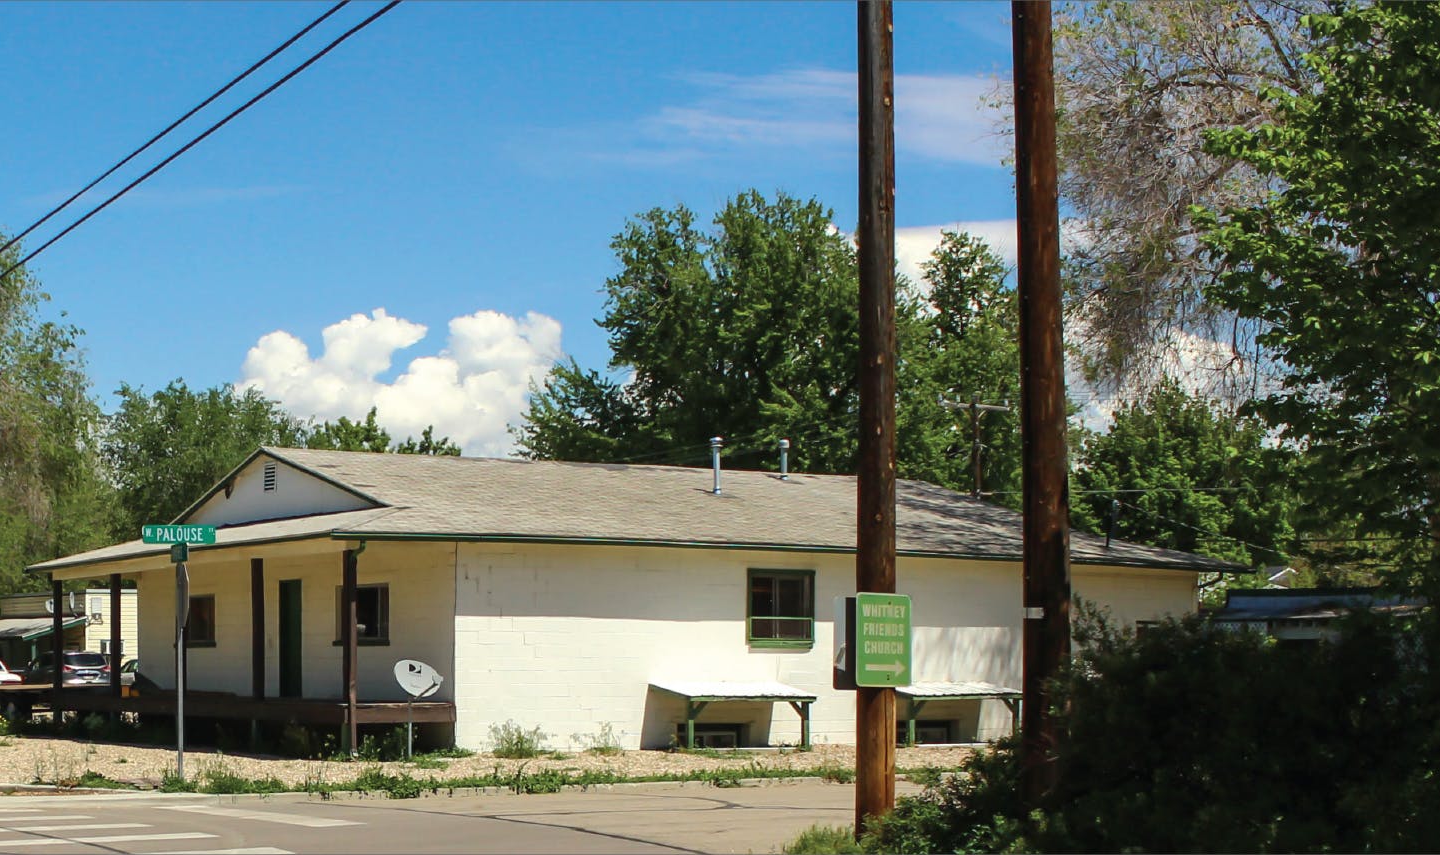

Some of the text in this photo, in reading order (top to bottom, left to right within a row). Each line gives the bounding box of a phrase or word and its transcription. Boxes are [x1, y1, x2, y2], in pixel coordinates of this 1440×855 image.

[156, 527, 204, 541] PALOUSE
[862, 603, 906, 618] WHITNEY
[863, 622, 905, 637] FRIENDS
[864, 640, 904, 655] CHURCH
